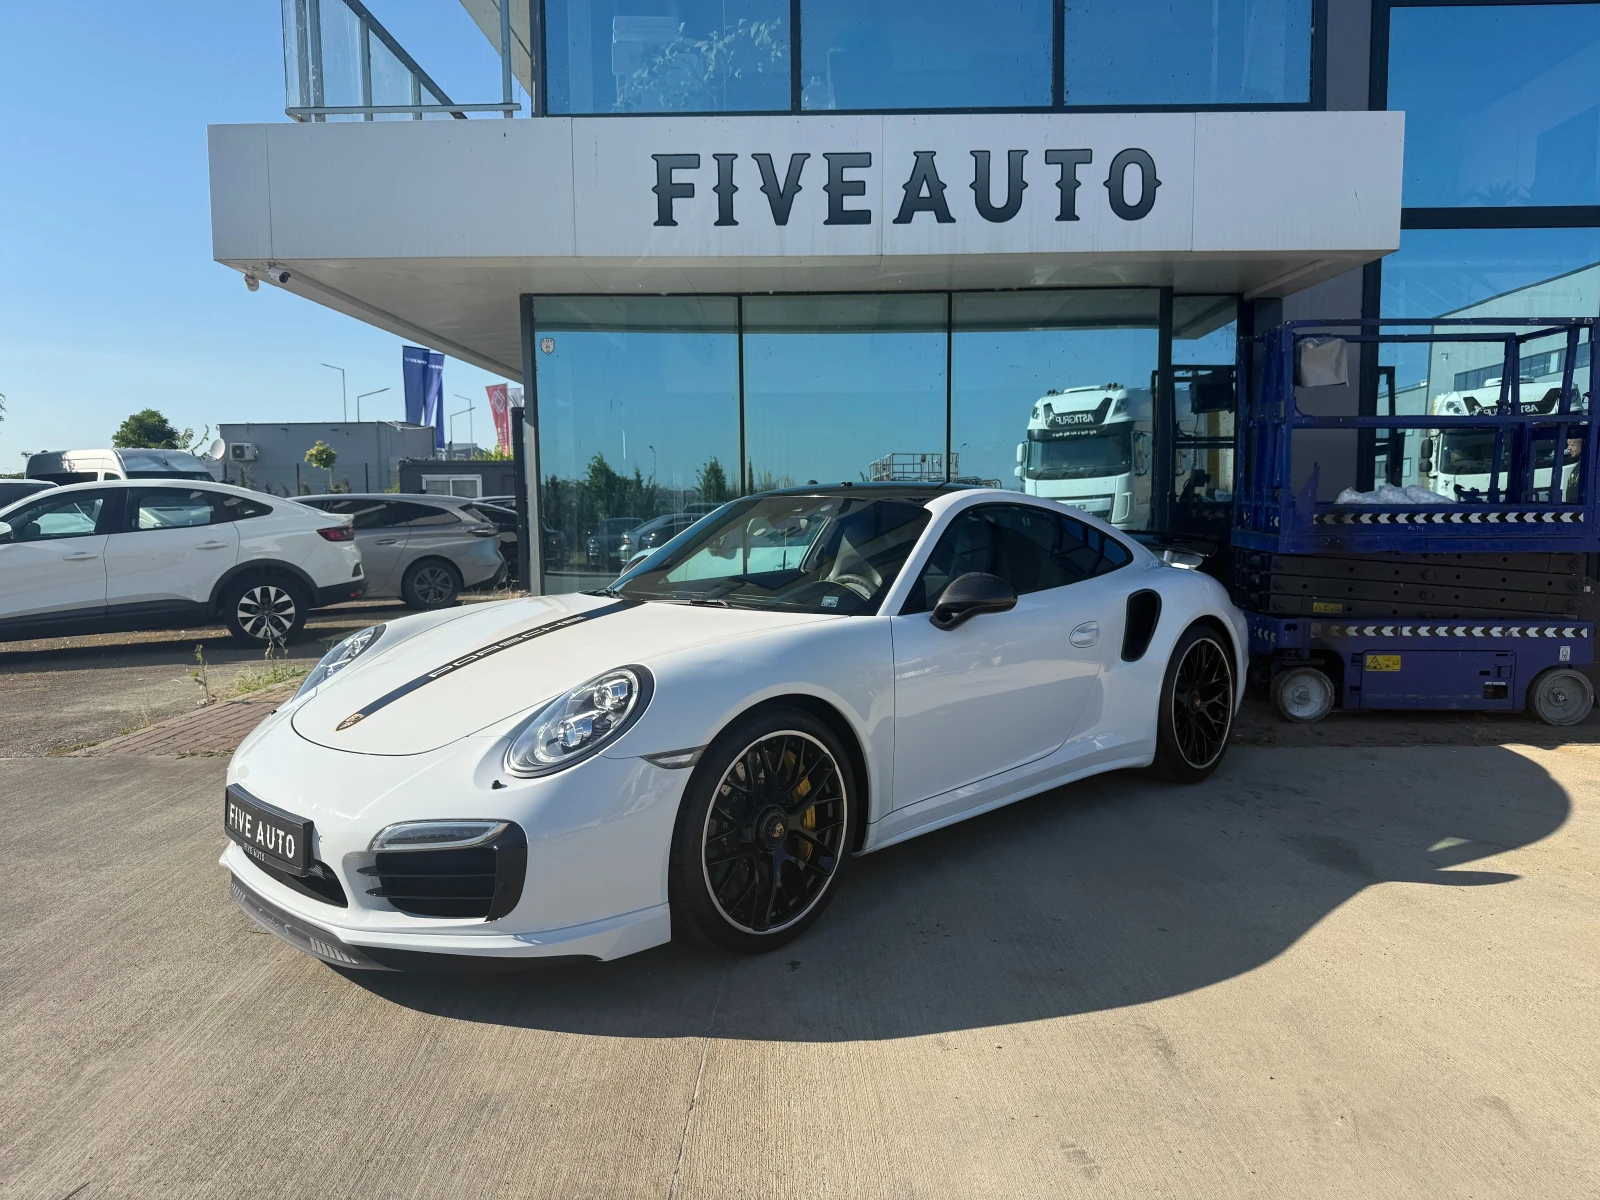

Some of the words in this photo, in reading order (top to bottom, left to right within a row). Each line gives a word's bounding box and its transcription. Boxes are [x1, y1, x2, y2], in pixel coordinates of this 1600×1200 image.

[651, 152, 872, 227] FIVE
[892, 147, 1163, 225] AUTO
[428, 615, 587, 678] PORSCHE
[229, 802, 252, 839] FIVE
[256, 820, 296, 859] AUTO
